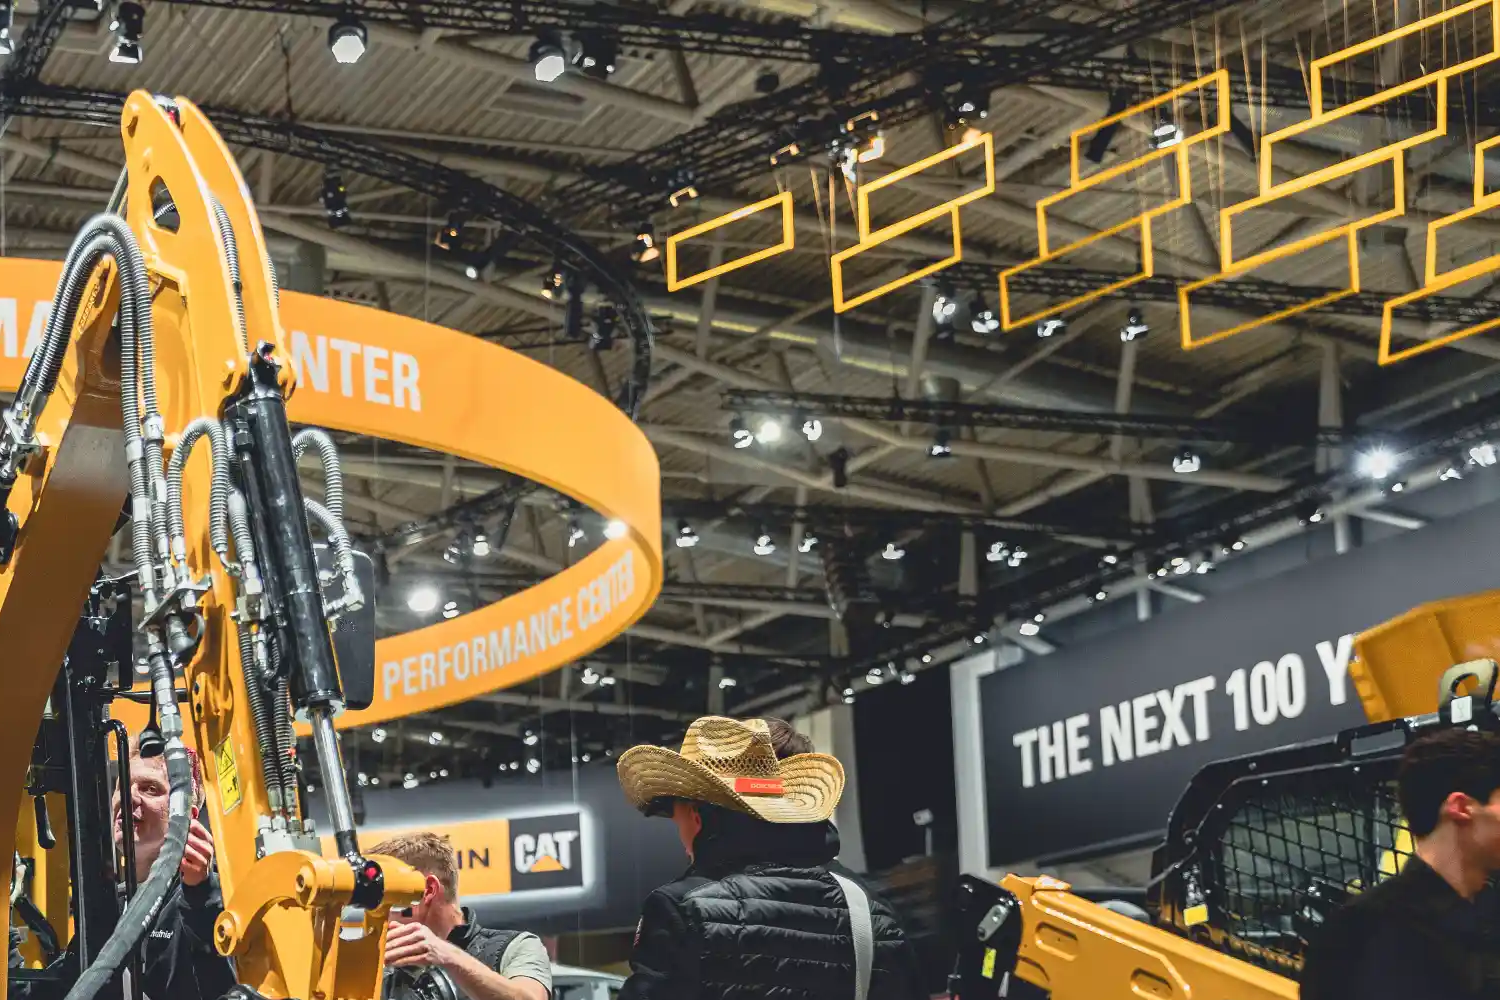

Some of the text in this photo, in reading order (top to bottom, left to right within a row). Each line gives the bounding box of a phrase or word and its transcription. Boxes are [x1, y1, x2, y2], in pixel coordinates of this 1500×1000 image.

[291, 330, 421, 412] NTER
[382, 549, 635, 701] PERFORMANCE CENTER
[1013, 712, 1093, 788] THE
[1100, 675, 1216, 767] NEXT
[1225, 653, 1307, 733] 100
[514, 830, 579, 874] CAT
